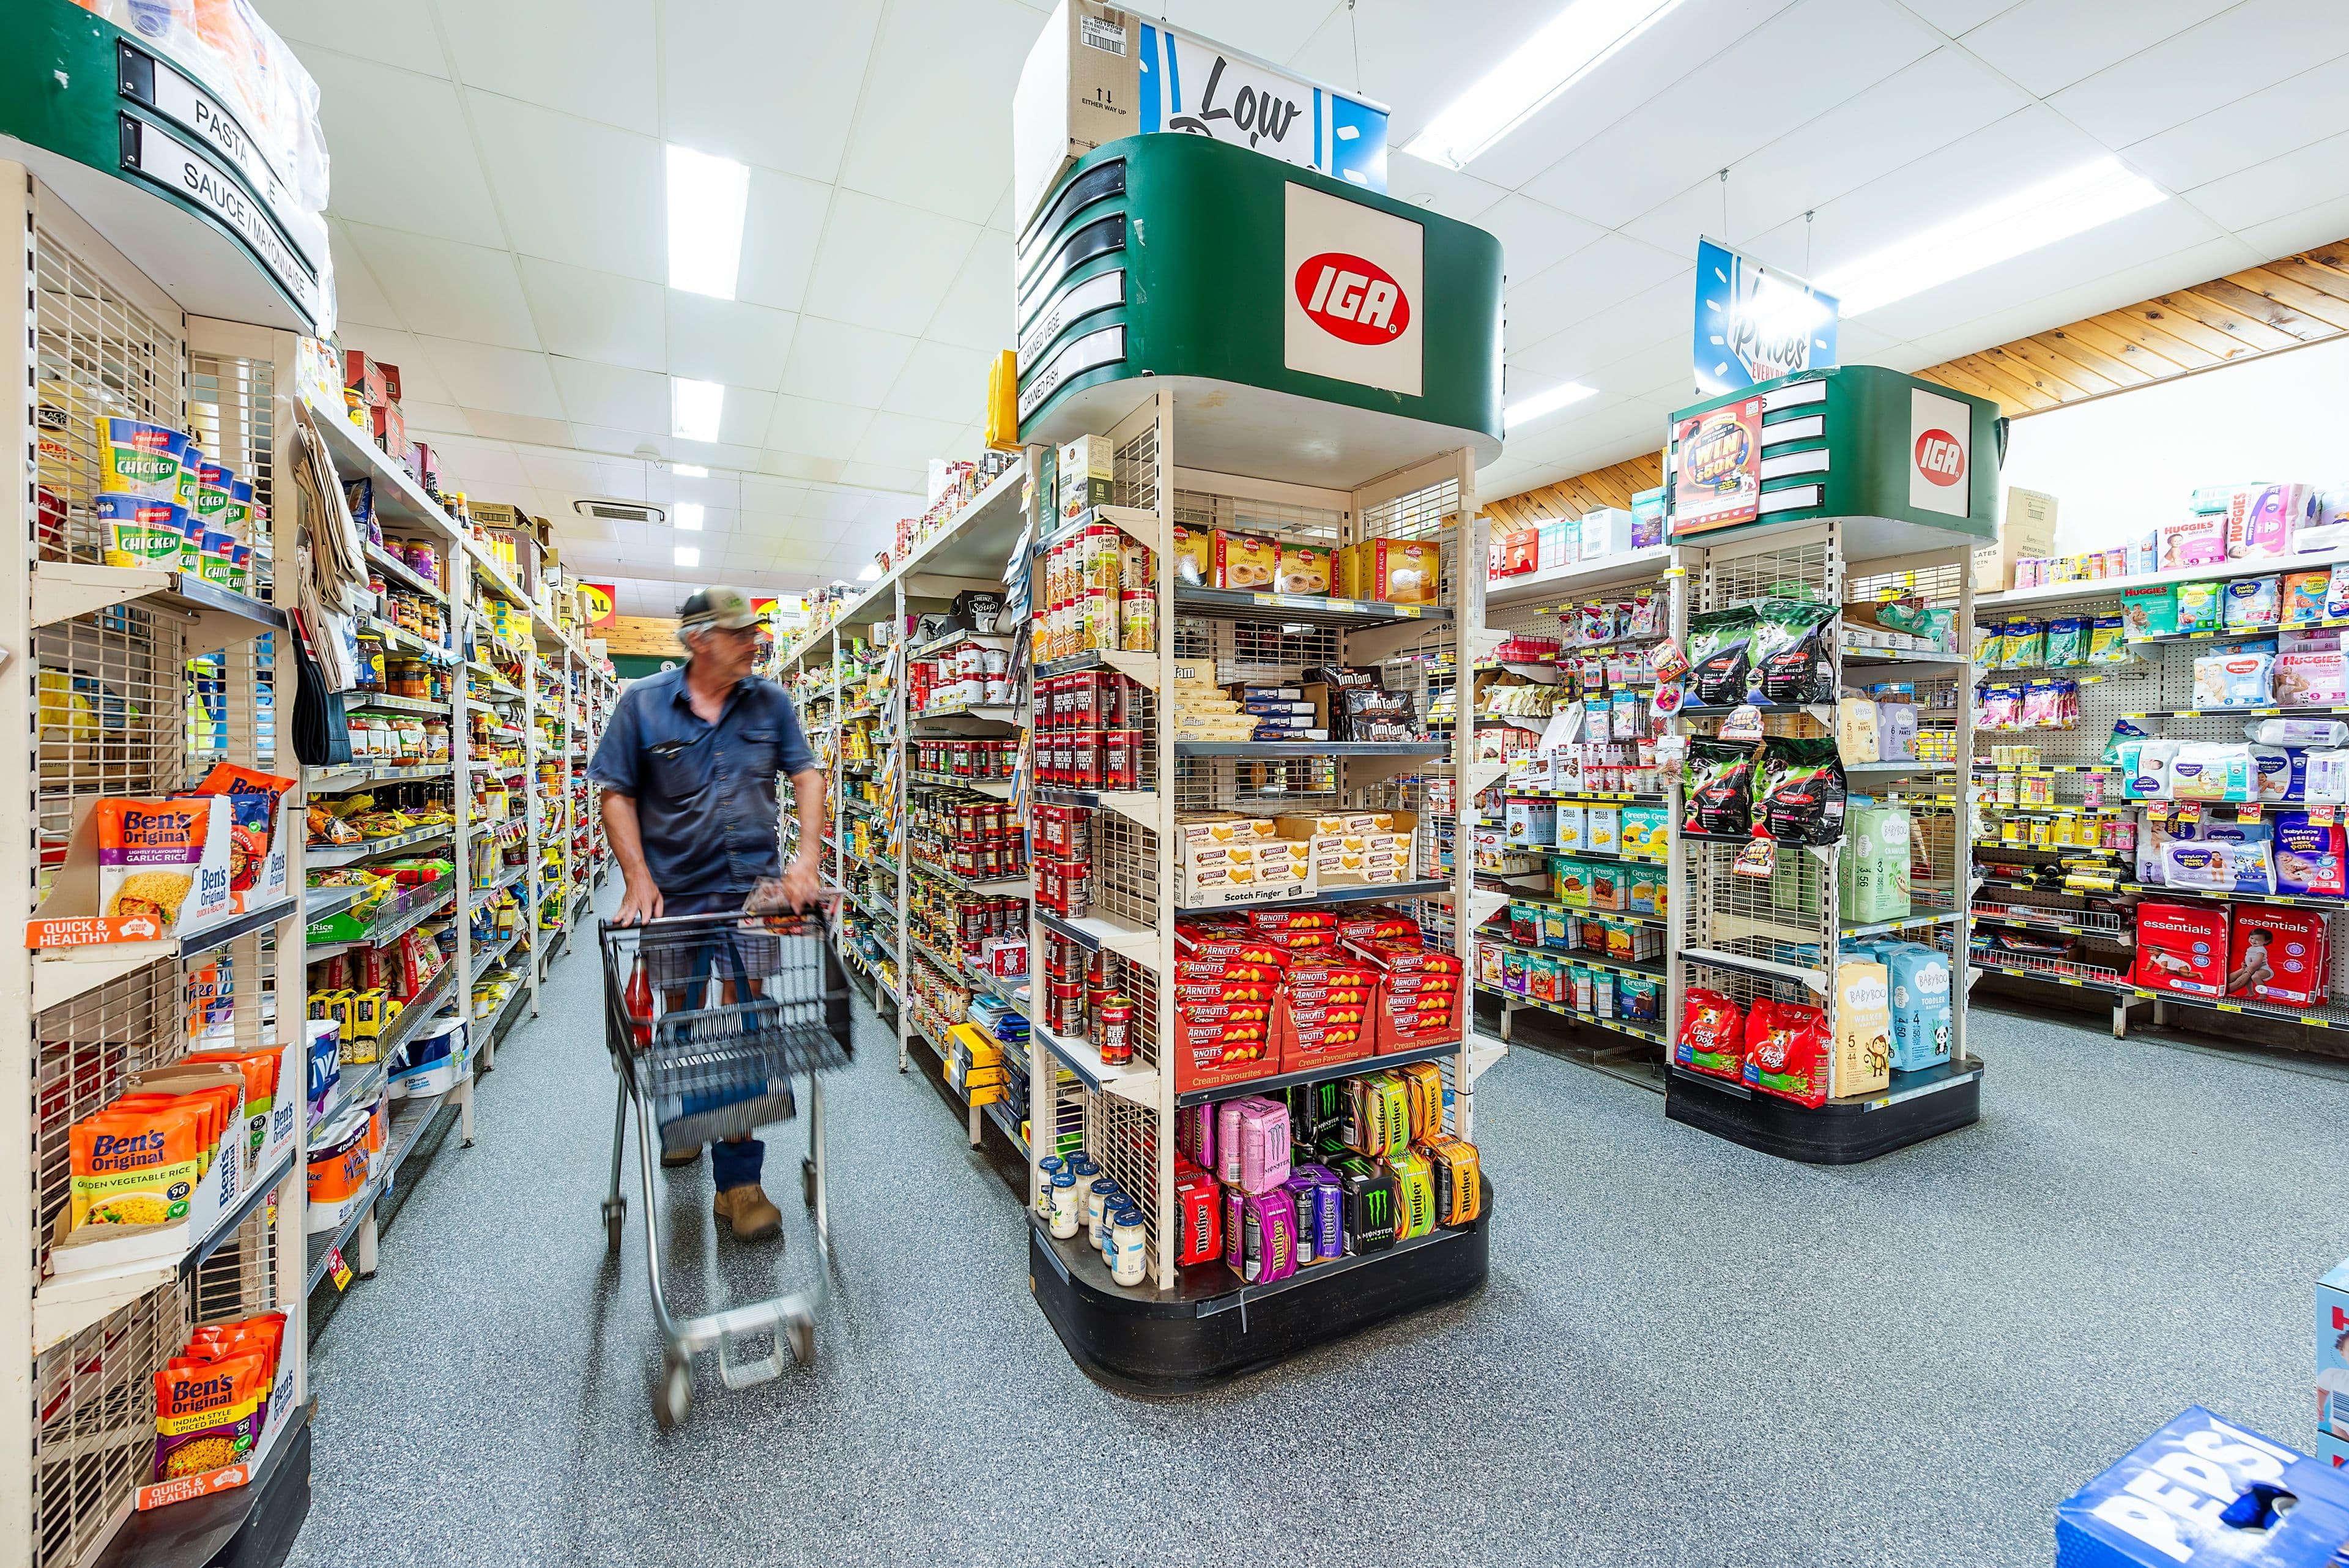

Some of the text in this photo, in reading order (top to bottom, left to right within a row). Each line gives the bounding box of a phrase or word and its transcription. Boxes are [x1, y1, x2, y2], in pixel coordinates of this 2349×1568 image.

[1082, 98, 1103, 109] EITHER
[1199, 56, 1302, 143] Low
[195, 99, 248, 168] PASTA
[184, 162, 246, 227] SAUCE
[253, 219, 305, 300] MAYONNAISE
[1307, 264, 1400, 329] IGA
[1023, 311, 1060, 365] CANNED VEGE
[1752, 361, 1775, 380] EVERY
[1023, 366, 1059, 411] CANNED FISH
[135, 434, 169, 444] Fantastic
[1695, 429, 1743, 467] WIN
[1920, 437, 1959, 475] IGA
[117, 460, 173, 475] CHICKEN
[1696, 453, 1739, 483] $50K
[137, 510, 171, 519] Fantastic
[2229, 492, 2246, 542] HUGGIES
[2164, 521, 2213, 535] HUGGIES
[122, 537, 177, 551] CHICKEN
[1098, 536, 1118, 544] Country
[2125, 587, 2167, 597] HUGGIES
[971, 603, 995, 613] Soup
[1129, 600, 1149, 609] Country
[1336, 672, 1372, 688] TimTam
[1364, 697, 1401, 710] TimTam
[1370, 723, 1406, 736] TimTam
[124, 811, 192, 830] Ben's
[124, 830, 191, 845] Original
[1885, 825, 1907, 837] BABYBOO
[1593, 867, 1614, 875] Green's
[1877, 861, 1882, 872] 3
[201, 866, 226, 891] Ben's
[201, 886, 225, 906] Original
[1255, 890, 1281, 900] Finger
[1512, 908, 1533, 916] Green's
[44, 920, 108, 934] QUICK &
[2144, 920, 2211, 935] essentials
[2240, 917, 2308, 933] essentials
[40, 932, 111, 946] HEALTHY
[1207, 946, 1240, 955] ARNOTT'S
[1189, 964, 1224, 972] ARNOTT'S
[1395, 957, 1423, 966] ARNOTT'S
[1624, 979, 1653, 988] Green's
[1919, 975, 1947, 987] BABYBOO
[1186, 986, 1220, 995] ARNOTT'S
[1850, 989, 1886, 1003] BABYBOO
[1921, 996, 1945, 1005] TODDLER
[1195, 1007, 1228, 1016] ARNOTT'S
[1913, 1013, 1920, 1025] 4
[1693, 1028, 1716, 1039] Lucky
[1696, 1035, 1713, 1047] Dog
[1849, 1035, 1855, 1047] 5
[1393, 1036, 1449, 1050] Cream Favourites
[1298, 1051, 1359, 1068] Cream Favourites
[1761, 1055, 1782, 1068] Dog
[1193, 1069, 1261, 1086] Cream Favourites
[273, 1102, 293, 1124] Ben's
[273, 1119, 293, 1145] Original
[92, 1129, 165, 1157] Ben's
[92, 1149, 164, 1171] Original
[109, 1172, 167, 1186] VEGETABLE
[169, 1166, 190, 1177] RICE
[220, 1143, 230, 1208] Ben's
[171, 1186, 185, 1197] 90
[1323, 1198, 1336, 1246] Mother
[1196, 1205, 1208, 1255] Mother
[1272, 1220, 1285, 1272] Mother
[173, 1374, 233, 1402] Ben's
[274, 1369, 293, 1403] Ben's
[172, 1391, 232, 1414] Original
[173, 1409, 231, 1427] INDIAN STYLE
[176, 1416, 229, 1433] SPICED RICE
[237, 1421, 250, 1432] 90
[152, 1477, 203, 1498] QUICK &
[2091, 1416, 2300, 1563] PEPSI
[149, 1486, 206, 1508] HEALTHY
